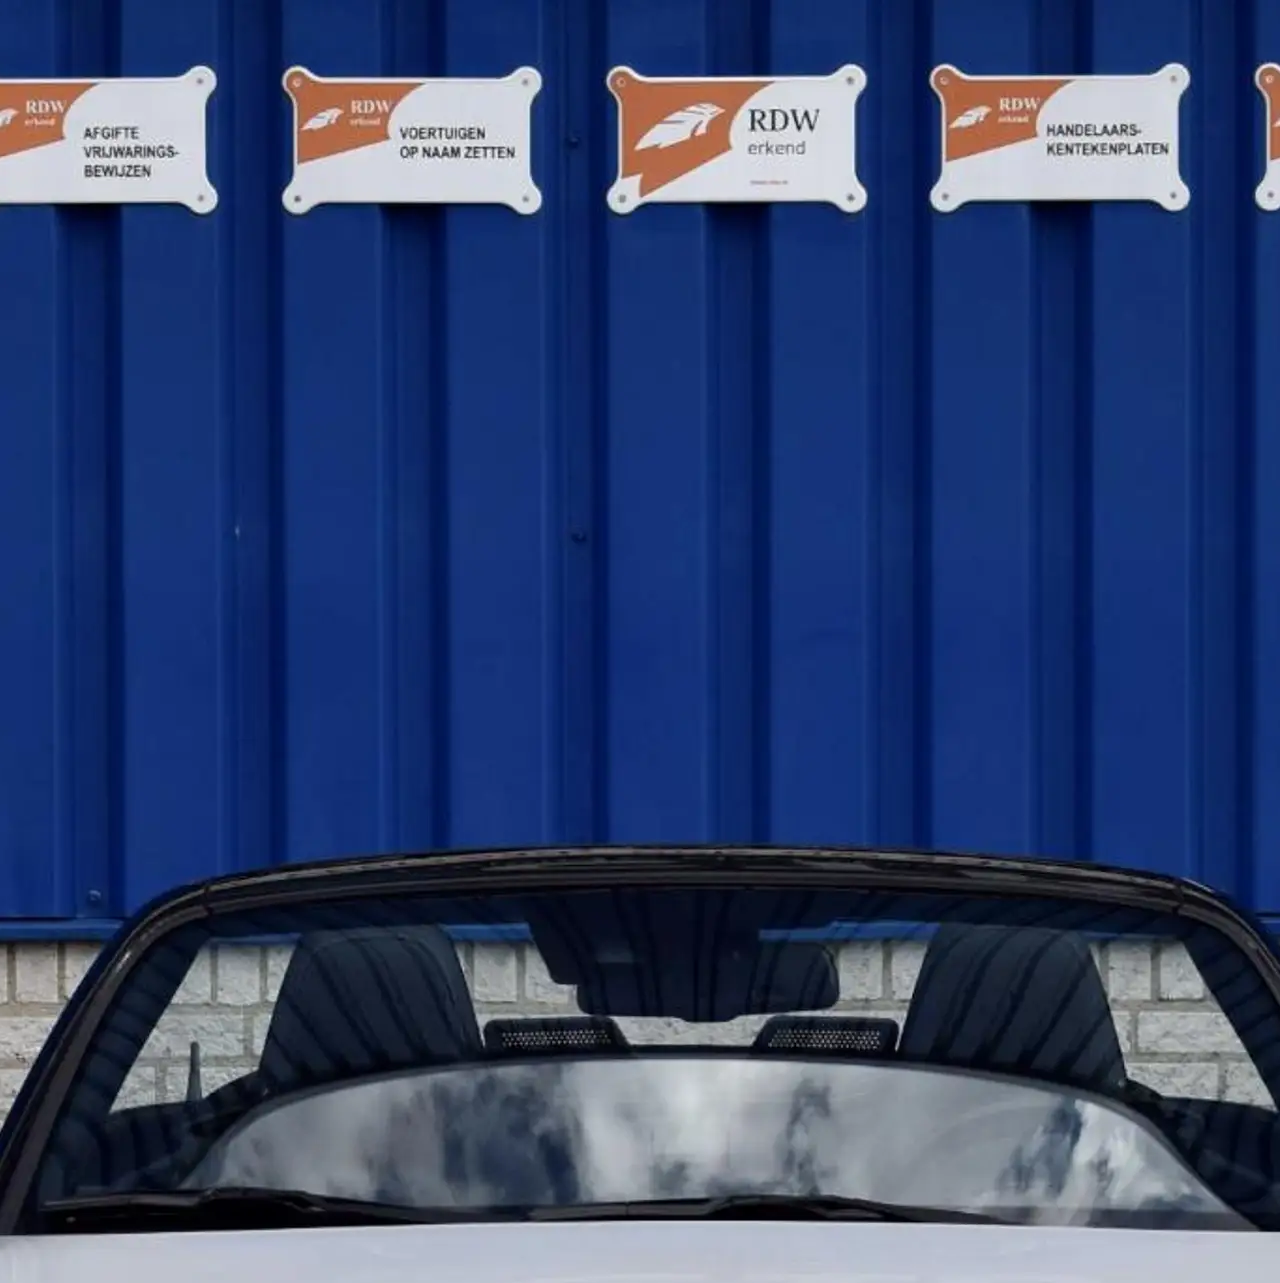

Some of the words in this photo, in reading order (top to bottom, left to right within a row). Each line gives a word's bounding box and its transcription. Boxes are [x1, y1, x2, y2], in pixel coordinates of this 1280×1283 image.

[25, 99, 68, 114] RDW
[350, 99, 393, 114] RDW
[999, 97, 1041, 111] RDW
[748, 108, 820, 133] RDW
[83, 126, 140, 141] AFGIFTE
[399, 126, 486, 141] VOERTUIGEN
[1046, 123, 1143, 137] HANDELAARS-
[83, 145, 181, 160] VRIJWARINGS-
[399, 145, 419, 160] OP
[422, 145, 461, 160] NAAM
[463, 145, 516, 160] ZETTEN
[747, 140, 807, 156] erkend
[1046, 141, 1169, 156] KENTEKENPLATEN
[83, 164, 152, 179] BEWIJZEN
